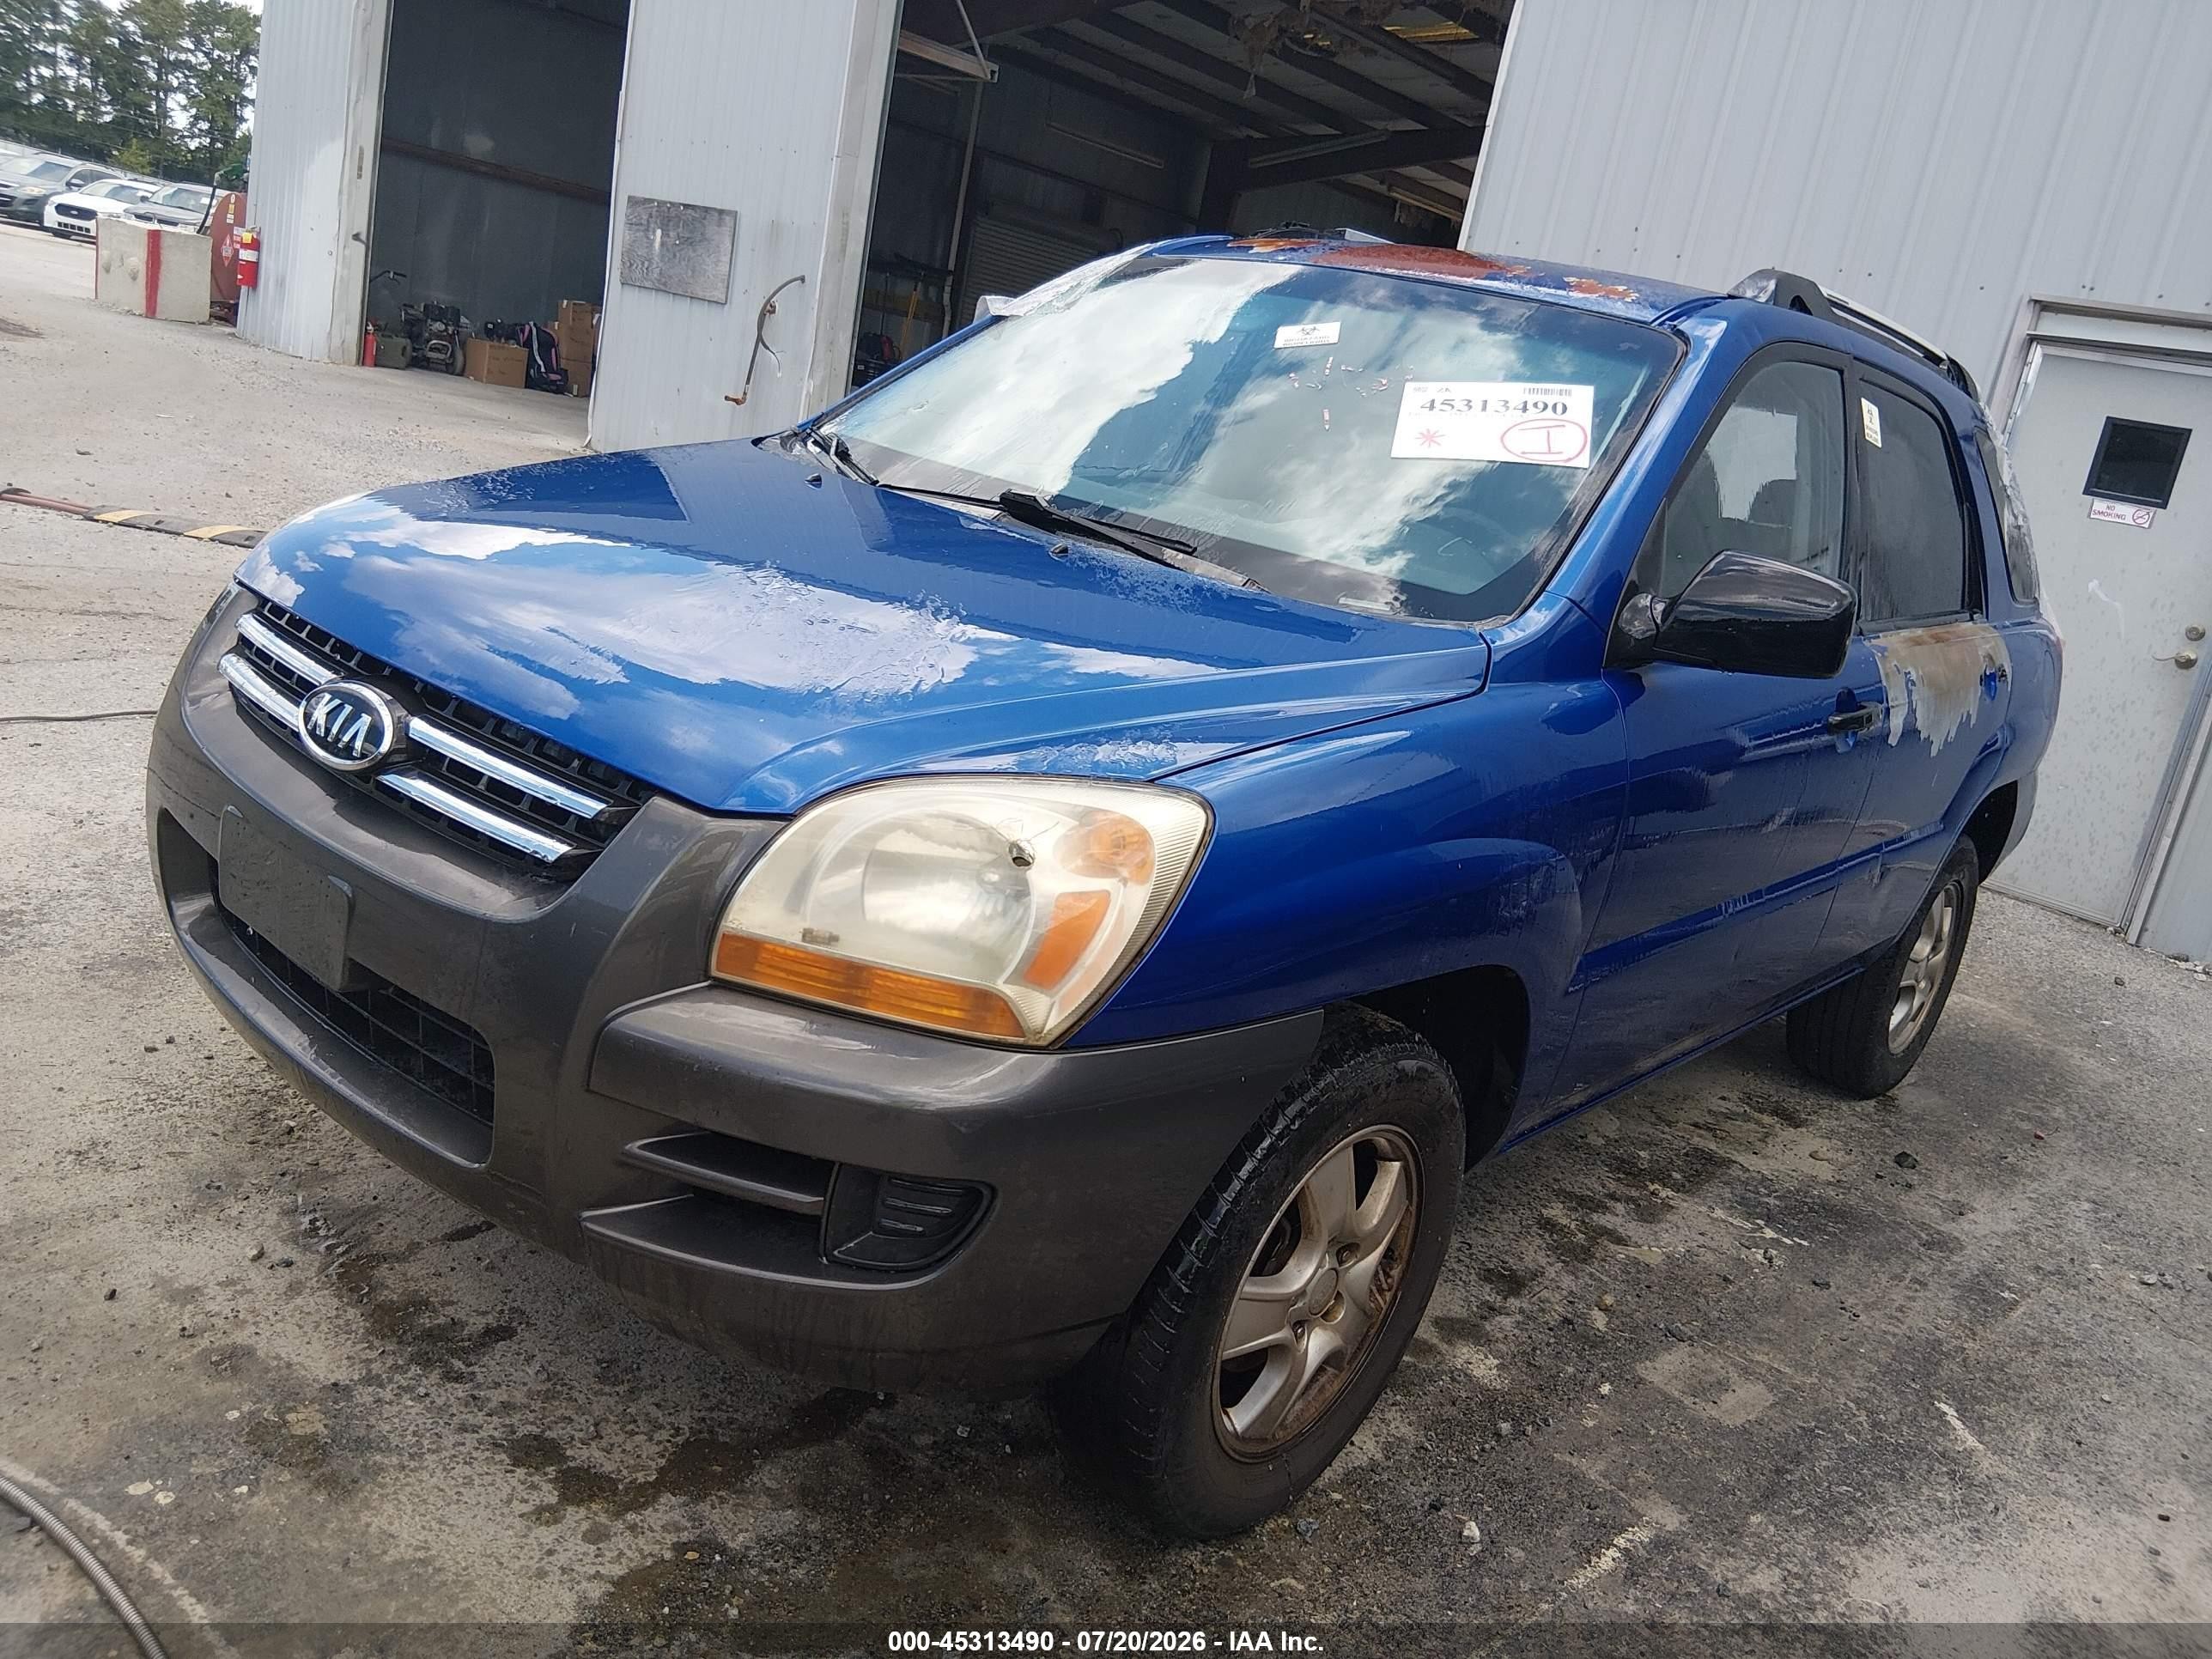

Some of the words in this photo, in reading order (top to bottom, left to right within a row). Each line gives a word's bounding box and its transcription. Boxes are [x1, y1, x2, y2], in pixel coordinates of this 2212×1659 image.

[1420, 398, 1568, 416] 45313490
[2092, 508, 2126, 520] SMOKING
[307, 692, 373, 758] KIA
